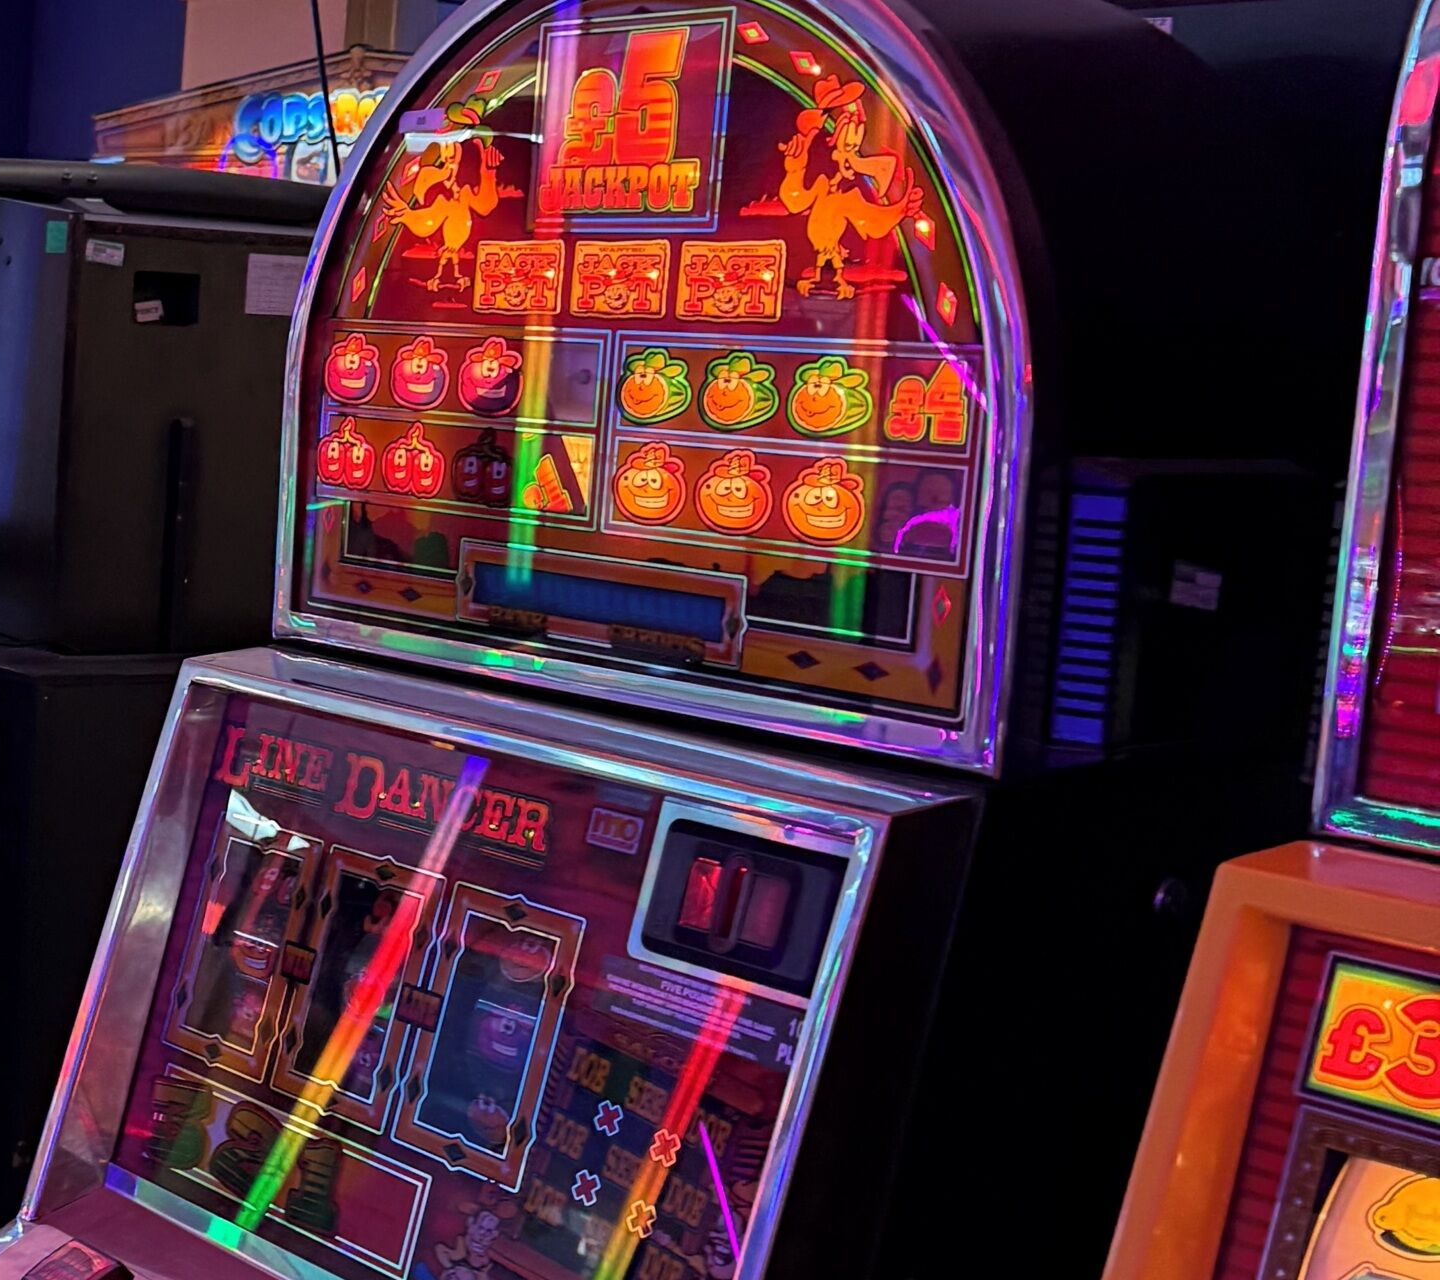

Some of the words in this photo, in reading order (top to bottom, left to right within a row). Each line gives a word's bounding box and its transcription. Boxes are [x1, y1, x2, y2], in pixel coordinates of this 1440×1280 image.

[558, 27, 690, 166] £5
[539, 159, 701, 214] JACKPOT
[479, 252, 557, 274] JACK
[576, 253, 661, 276] JACK
[682, 254, 778, 277] JACK
[884, 360, 967, 445] £4
[214, 725, 333, 791] LINE
[333, 751, 553, 852] DANCER
